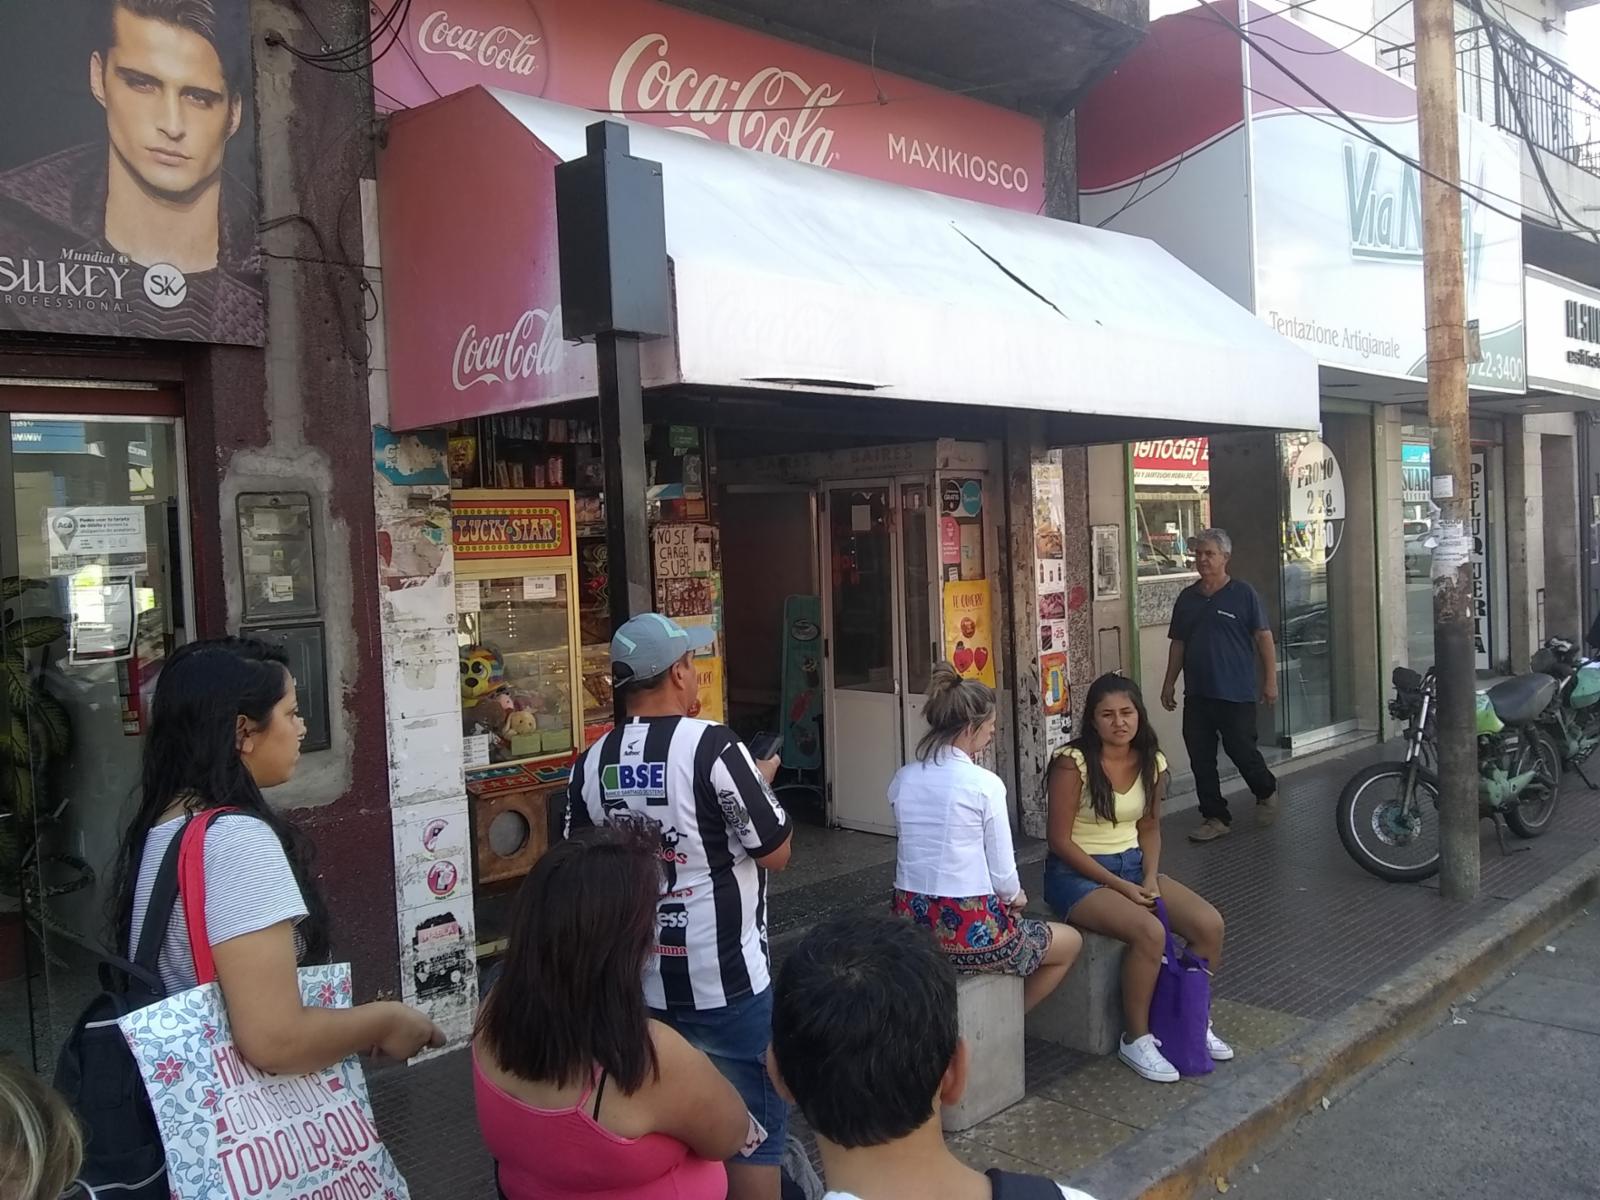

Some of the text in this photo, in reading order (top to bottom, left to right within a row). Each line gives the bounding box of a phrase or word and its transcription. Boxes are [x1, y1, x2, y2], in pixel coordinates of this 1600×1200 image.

[418, 11, 541, 76] Coca-Cola
[608, 33, 844, 167] Coca-Cola
[888, 133, 1029, 192] MAXIKIOSCO
[60, 247, 115, 264] Mundial
[0, 256, 130, 300] SILKEY
[4, 294, 133, 313] ROFESSIONAL
[1269, 311, 1400, 359] Tentazione Artigianale
[1466, 350, 1523, 383] 22-3400
[457, 518, 553, 542] LUCKY STAR
[657, 529, 687, 545] NO SE
[659, 545, 689, 560] CARGA
[659, 558, 692, 577] SUBE
[1470, 463, 1487, 654] PELUQUERIA
[619, 764, 664, 789] BSE
[656, 911, 689, 929] ess
[224, 1072, 338, 1135] CONSEGUIR
[217, 1129, 299, 1200] TODO
